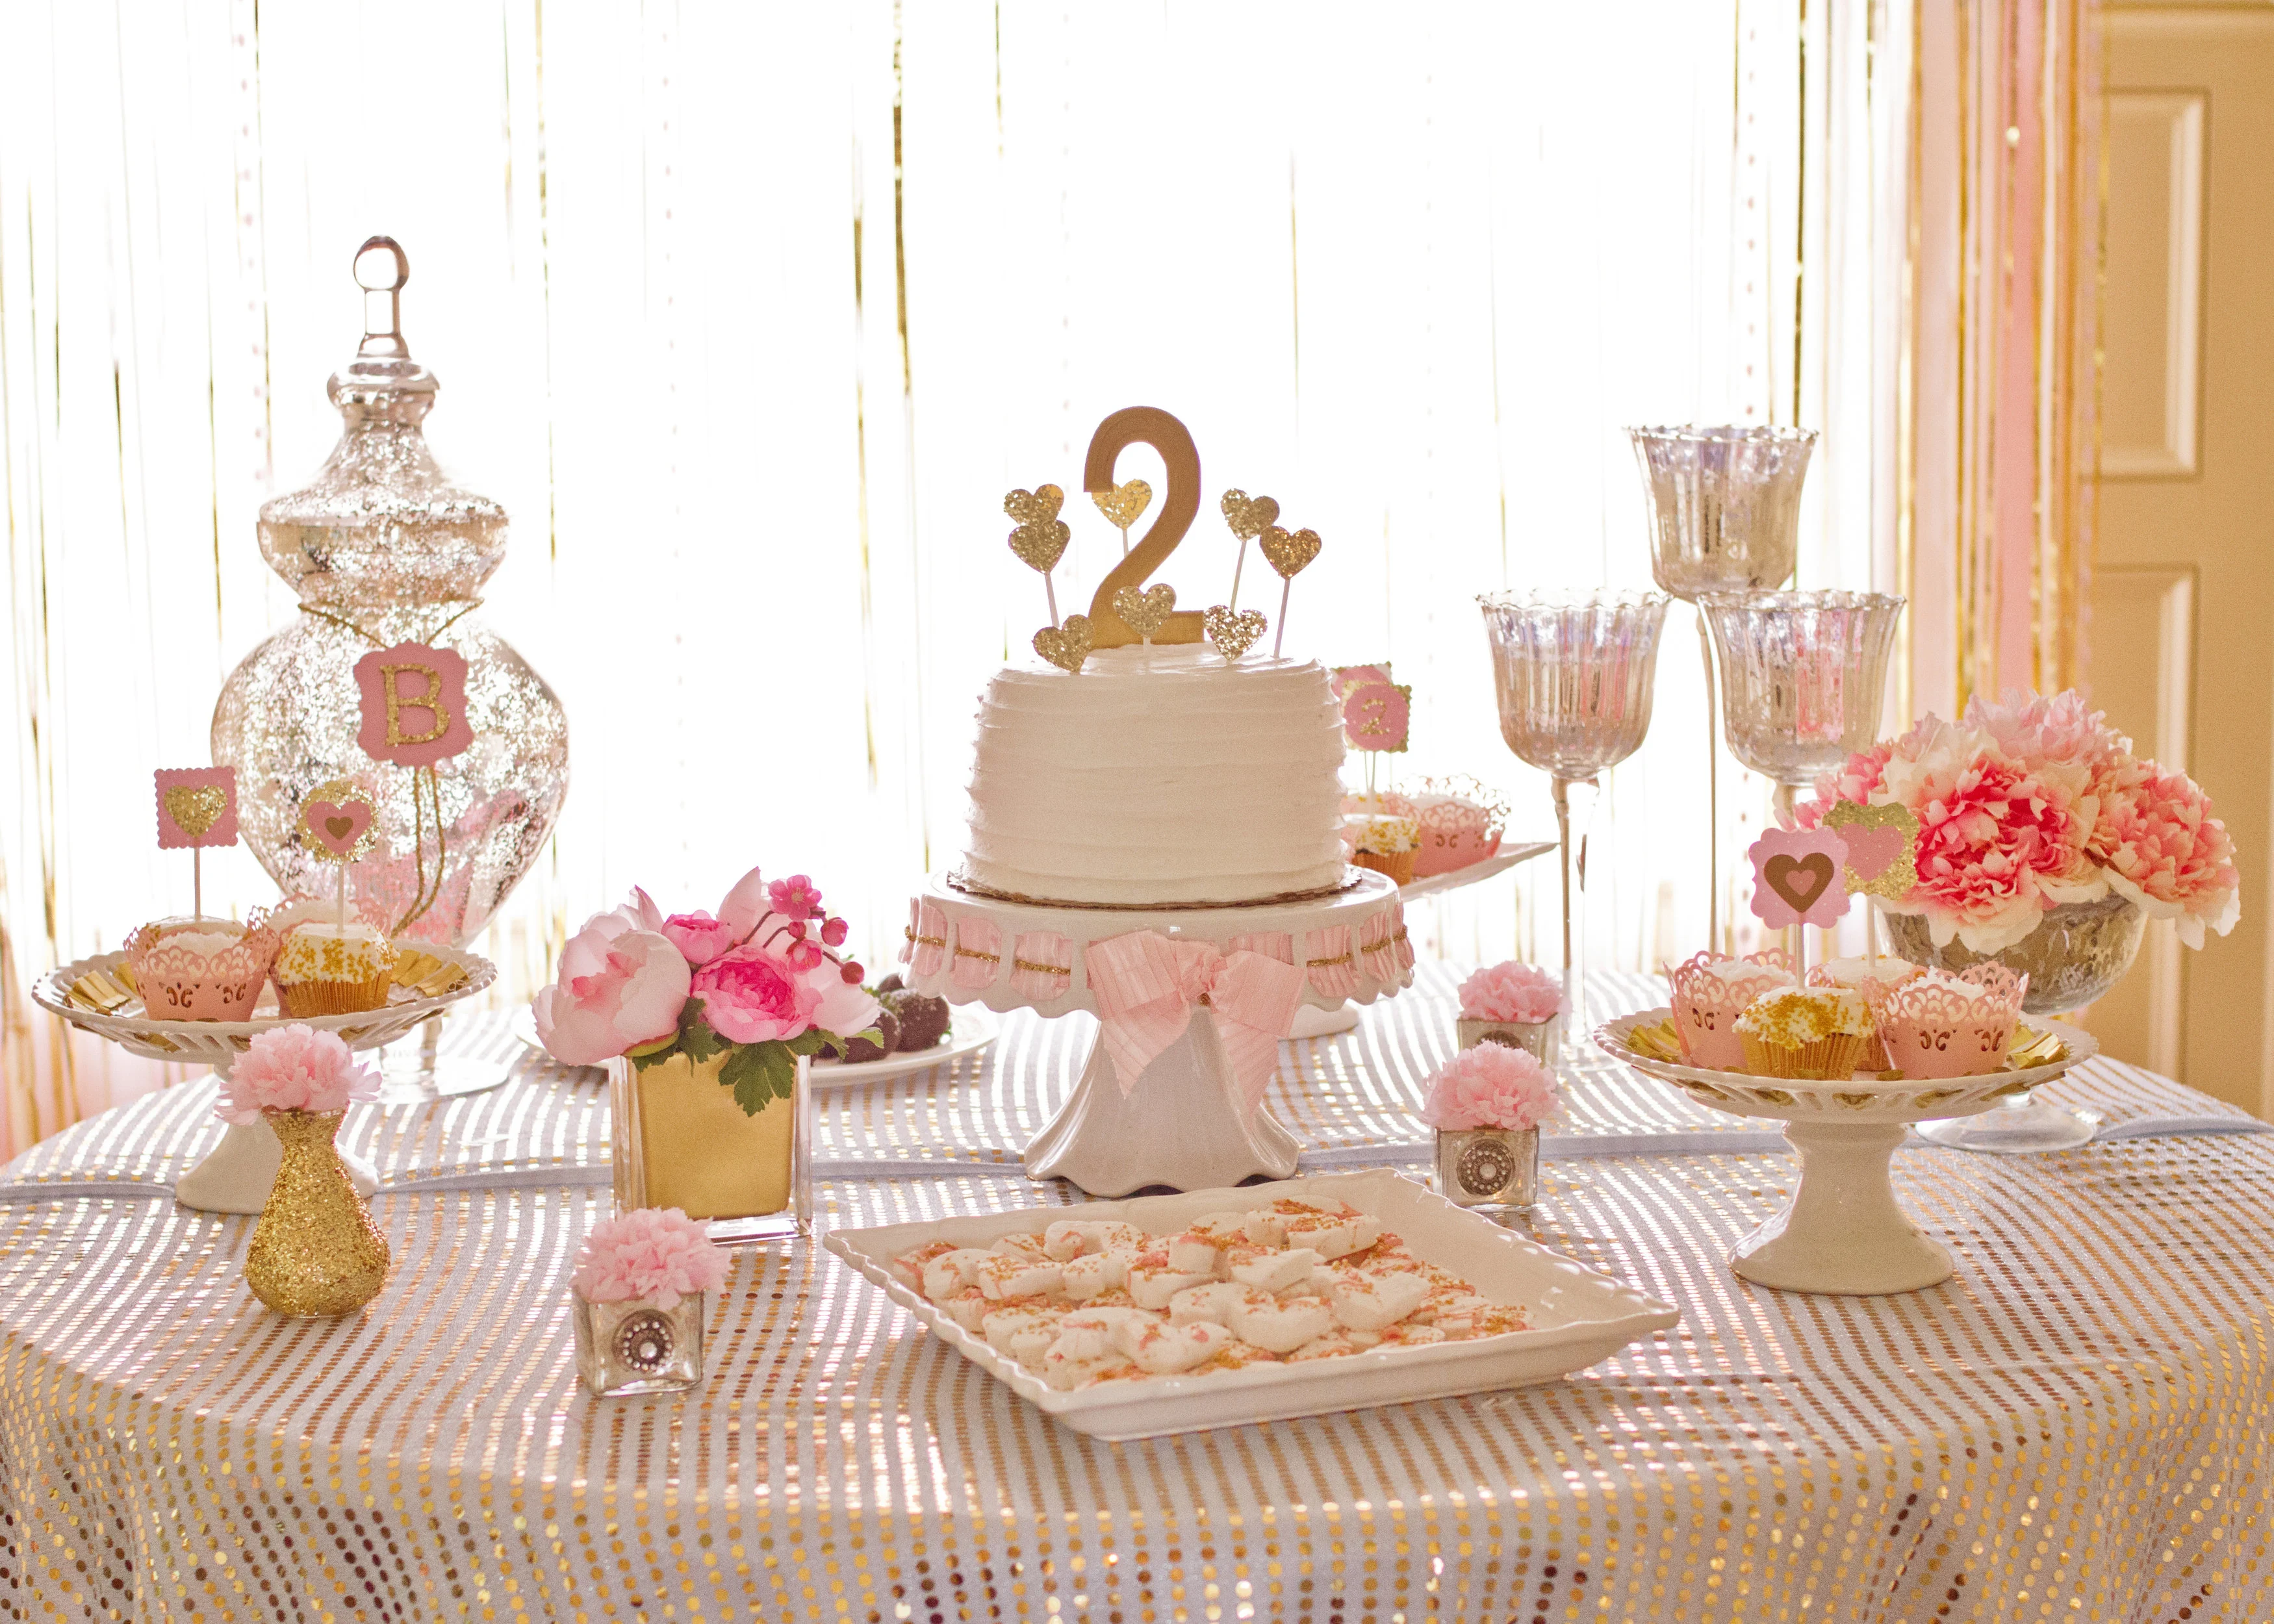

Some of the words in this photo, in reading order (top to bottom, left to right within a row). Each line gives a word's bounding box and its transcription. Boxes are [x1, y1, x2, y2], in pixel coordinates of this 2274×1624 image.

[1084, 405, 1204, 650] 2
[379, 663, 450, 747] B
[1360, 698, 1390, 735] 2
